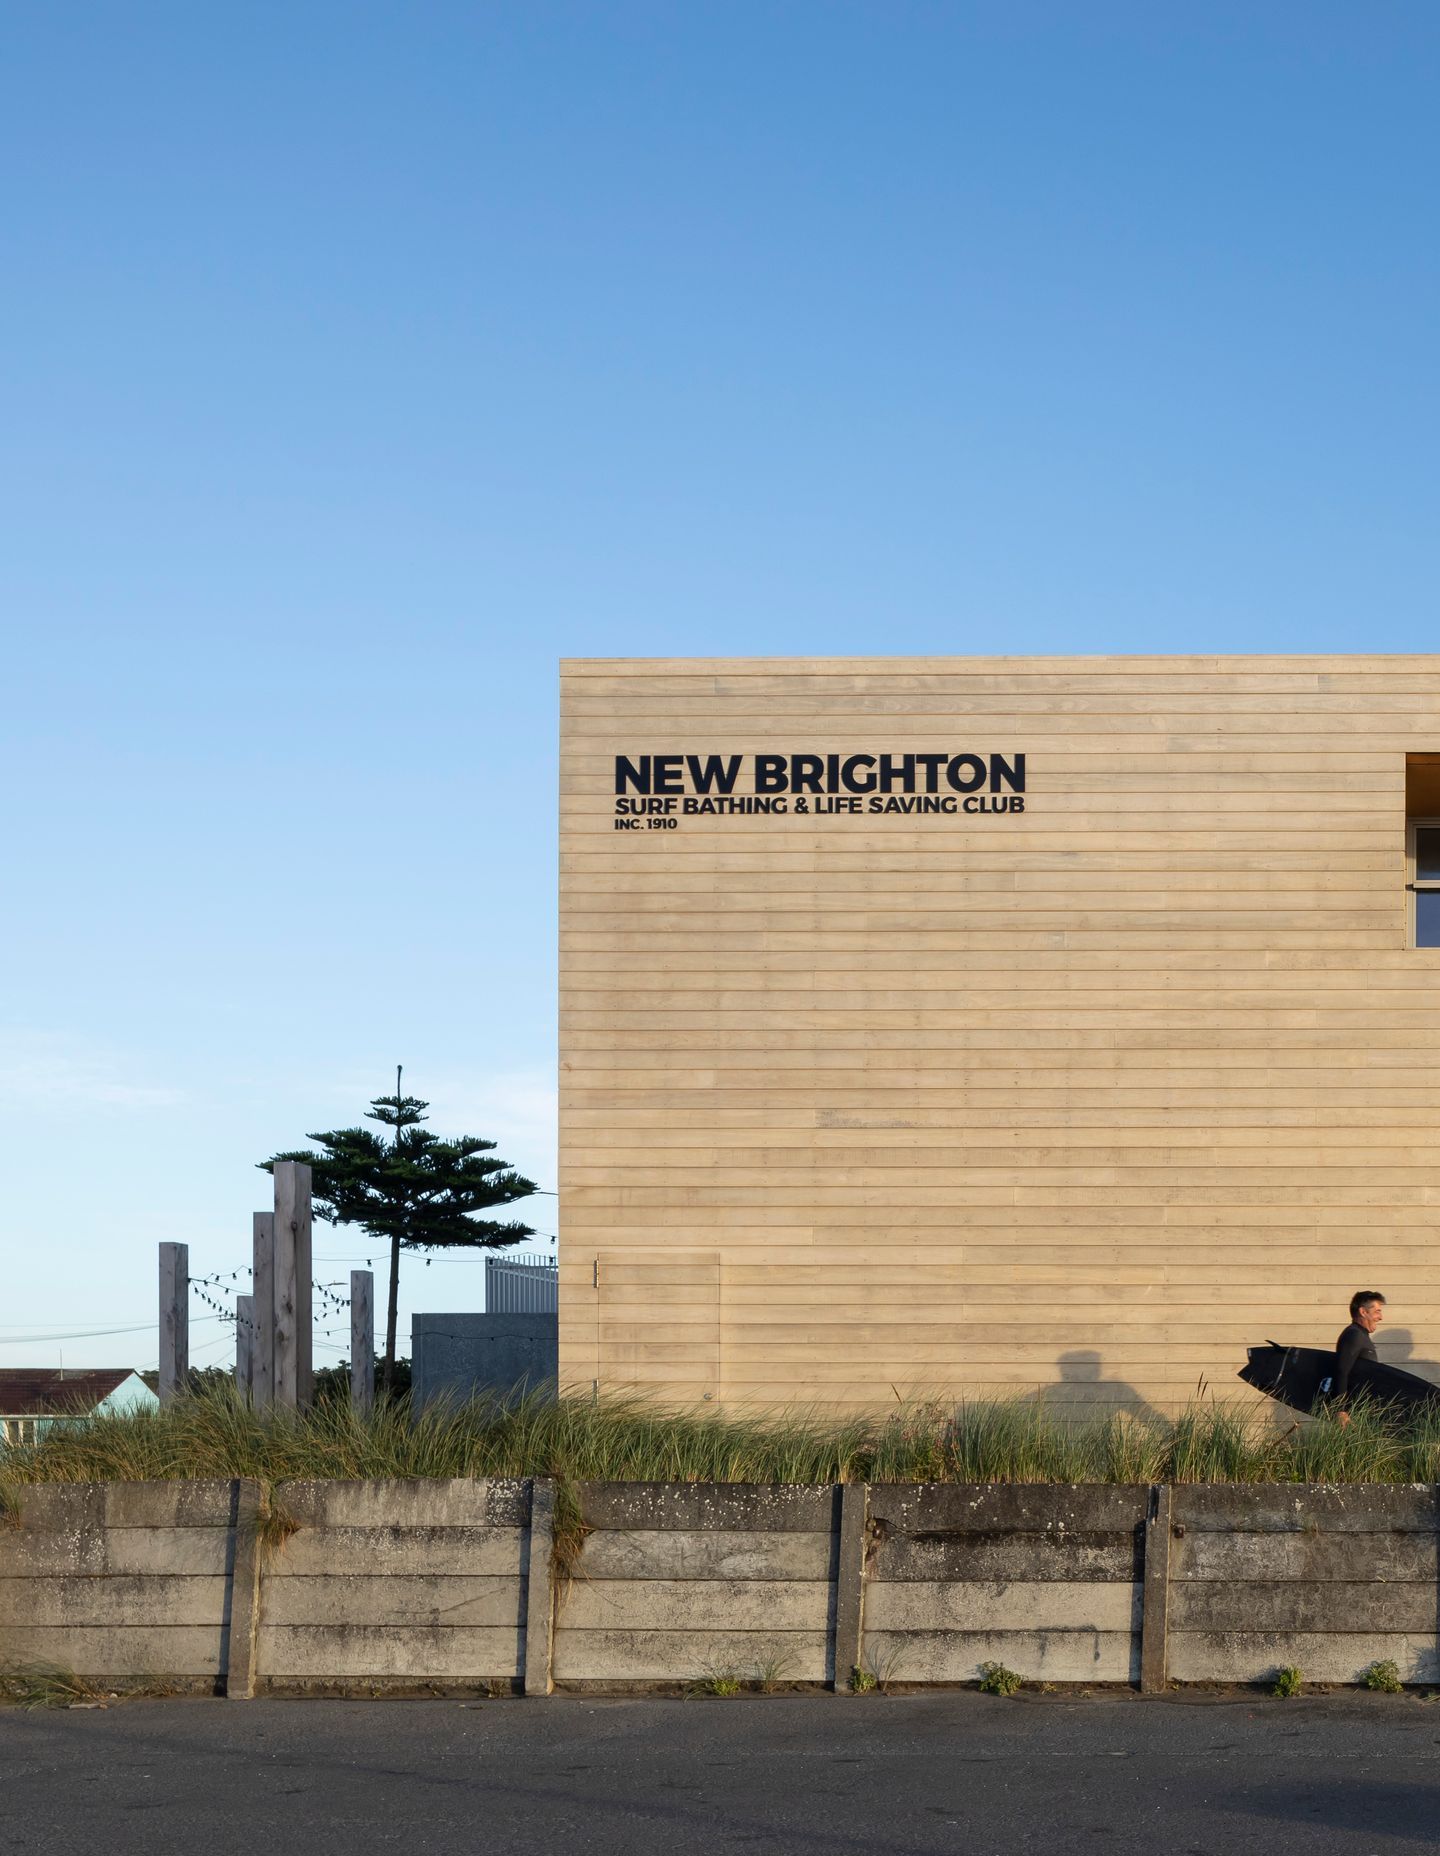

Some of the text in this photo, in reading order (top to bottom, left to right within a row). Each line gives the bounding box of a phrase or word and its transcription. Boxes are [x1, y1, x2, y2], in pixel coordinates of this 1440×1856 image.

[615, 753, 1025, 795] NEW BRIGHTON
[614, 796, 1025, 815] SURF BATHING & LIFE SAVING CLUB
[614, 818, 678, 830] INC. 1910
